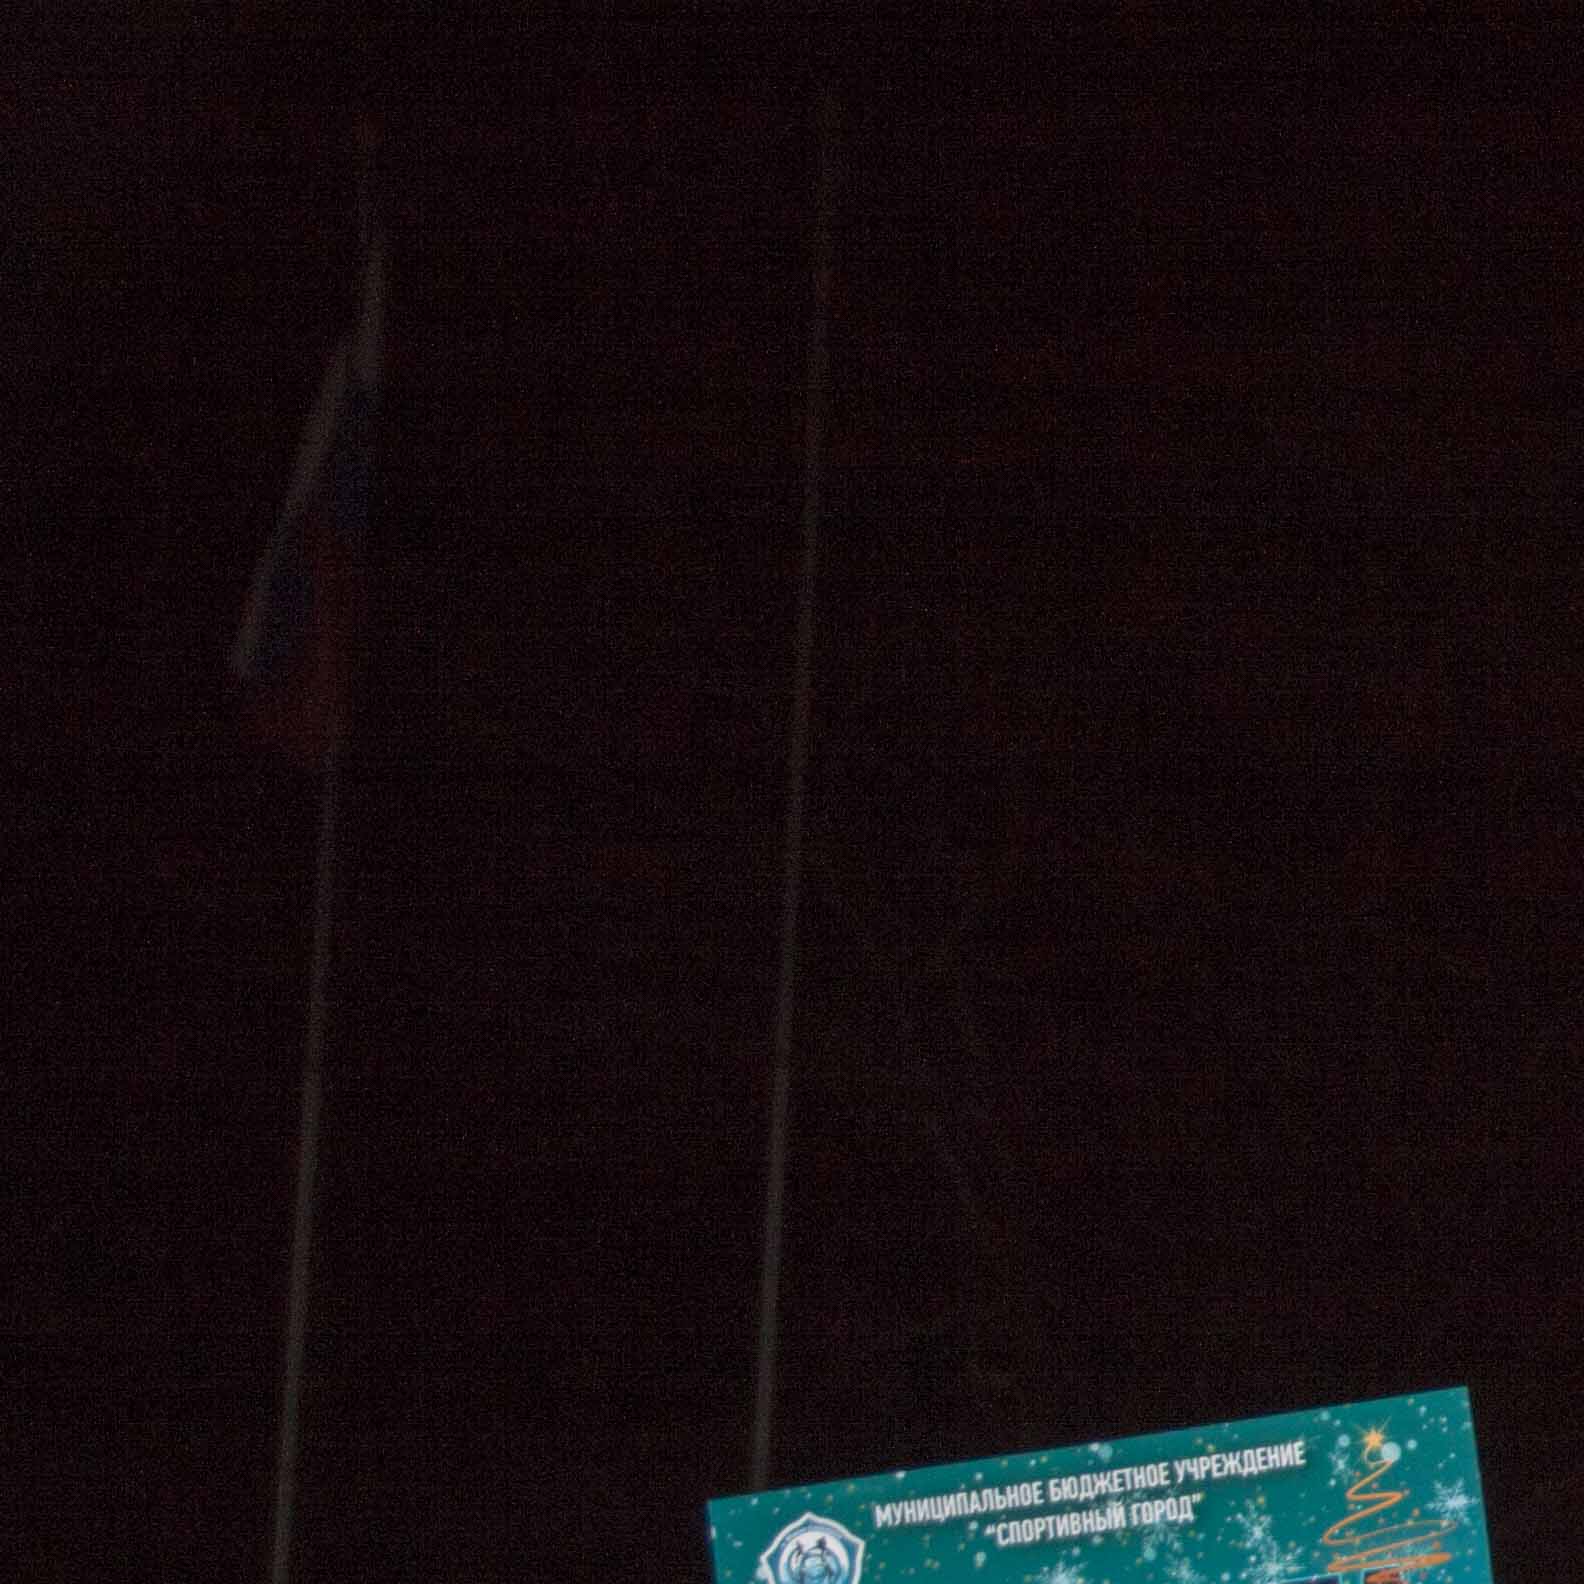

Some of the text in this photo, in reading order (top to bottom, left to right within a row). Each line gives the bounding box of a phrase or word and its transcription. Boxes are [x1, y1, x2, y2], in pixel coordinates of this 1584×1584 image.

[874, 1440, 1307, 1529] МУНИЦИПАЛЬНОЕ БЮДЖЕТНОЕ УЧРЕЖДЕНИЕ
